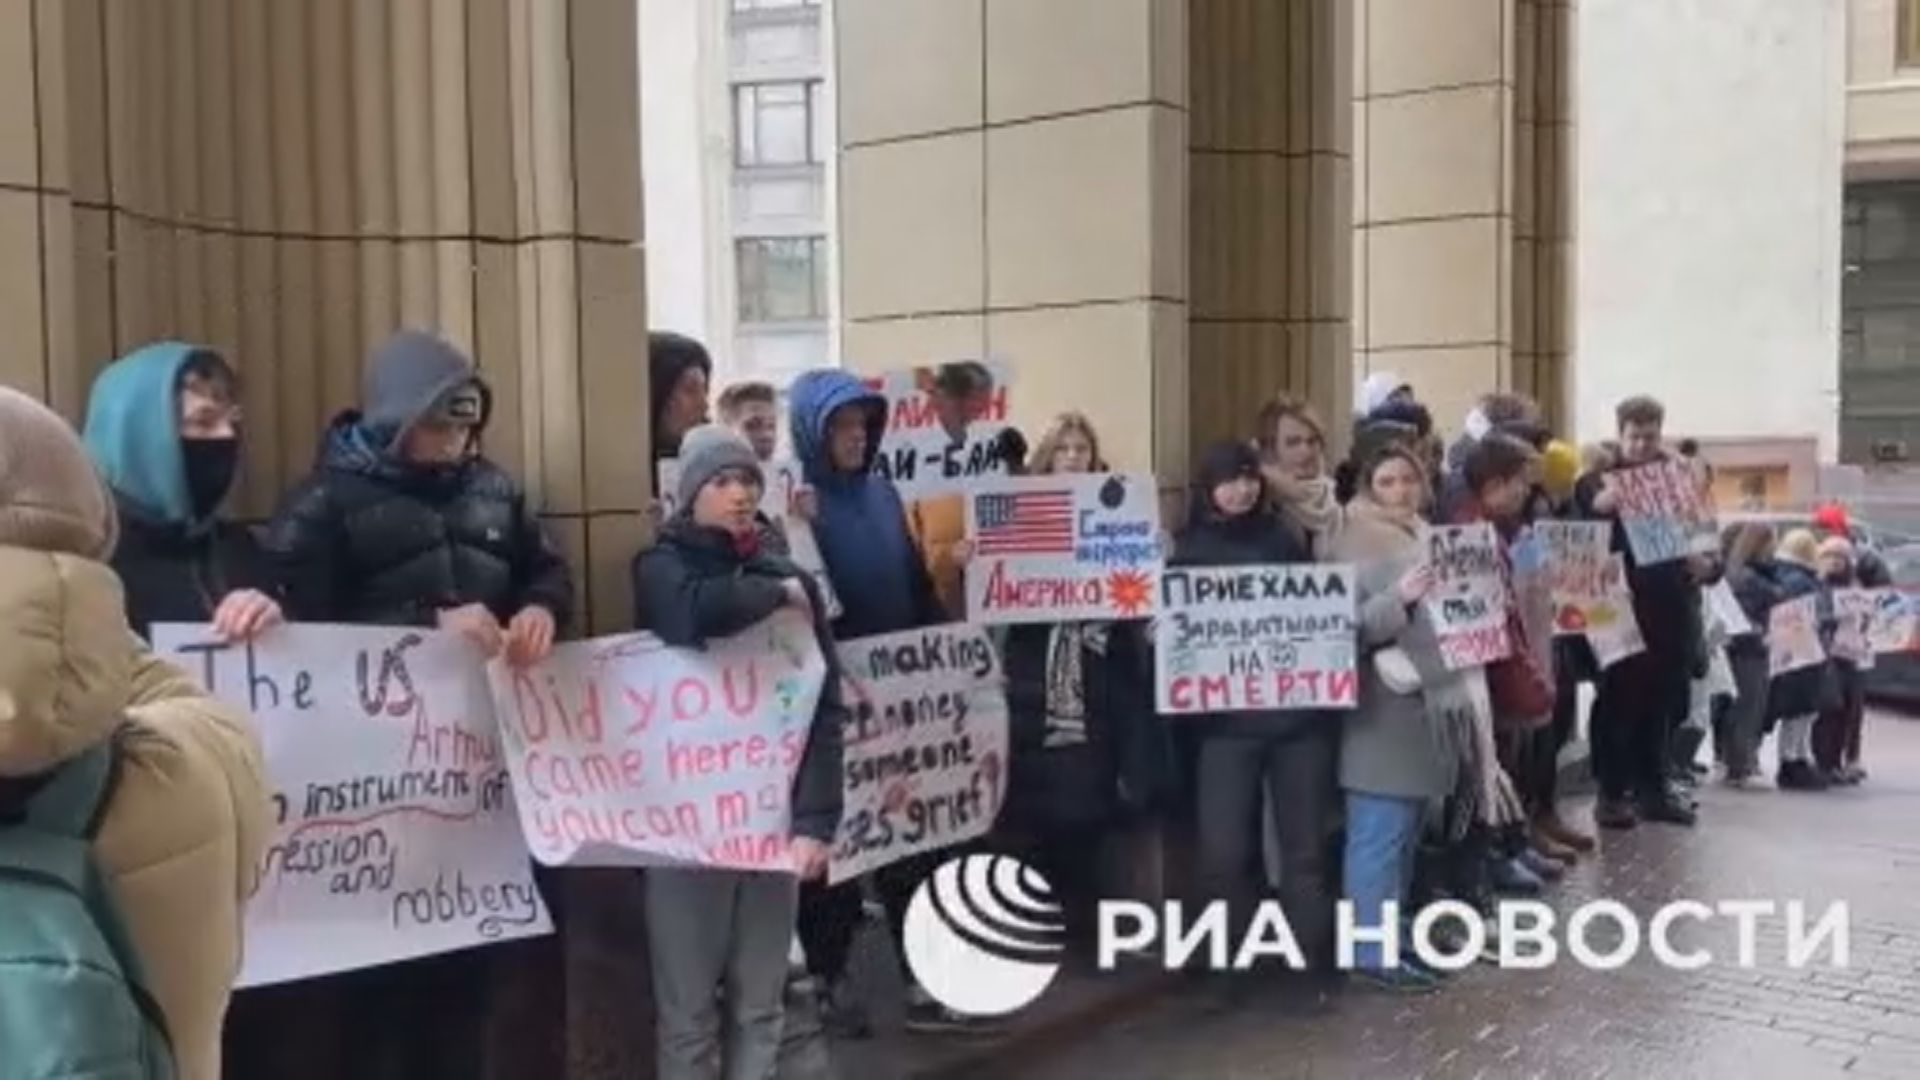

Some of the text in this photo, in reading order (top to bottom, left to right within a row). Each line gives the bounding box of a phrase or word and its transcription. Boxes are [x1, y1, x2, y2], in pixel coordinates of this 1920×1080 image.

[177, 632, 423, 717] The US
[1229, 649, 1265, 676] НА
[512, 664, 603, 744] Did
[1168, 668, 1358, 712] СМЕРТИ
[524, 747, 645, 799] came
[846, 735, 974, 790] someone
[302, 769, 470, 818] instrument
[329, 846, 398, 894] and
[392, 868, 538, 934] robbery
